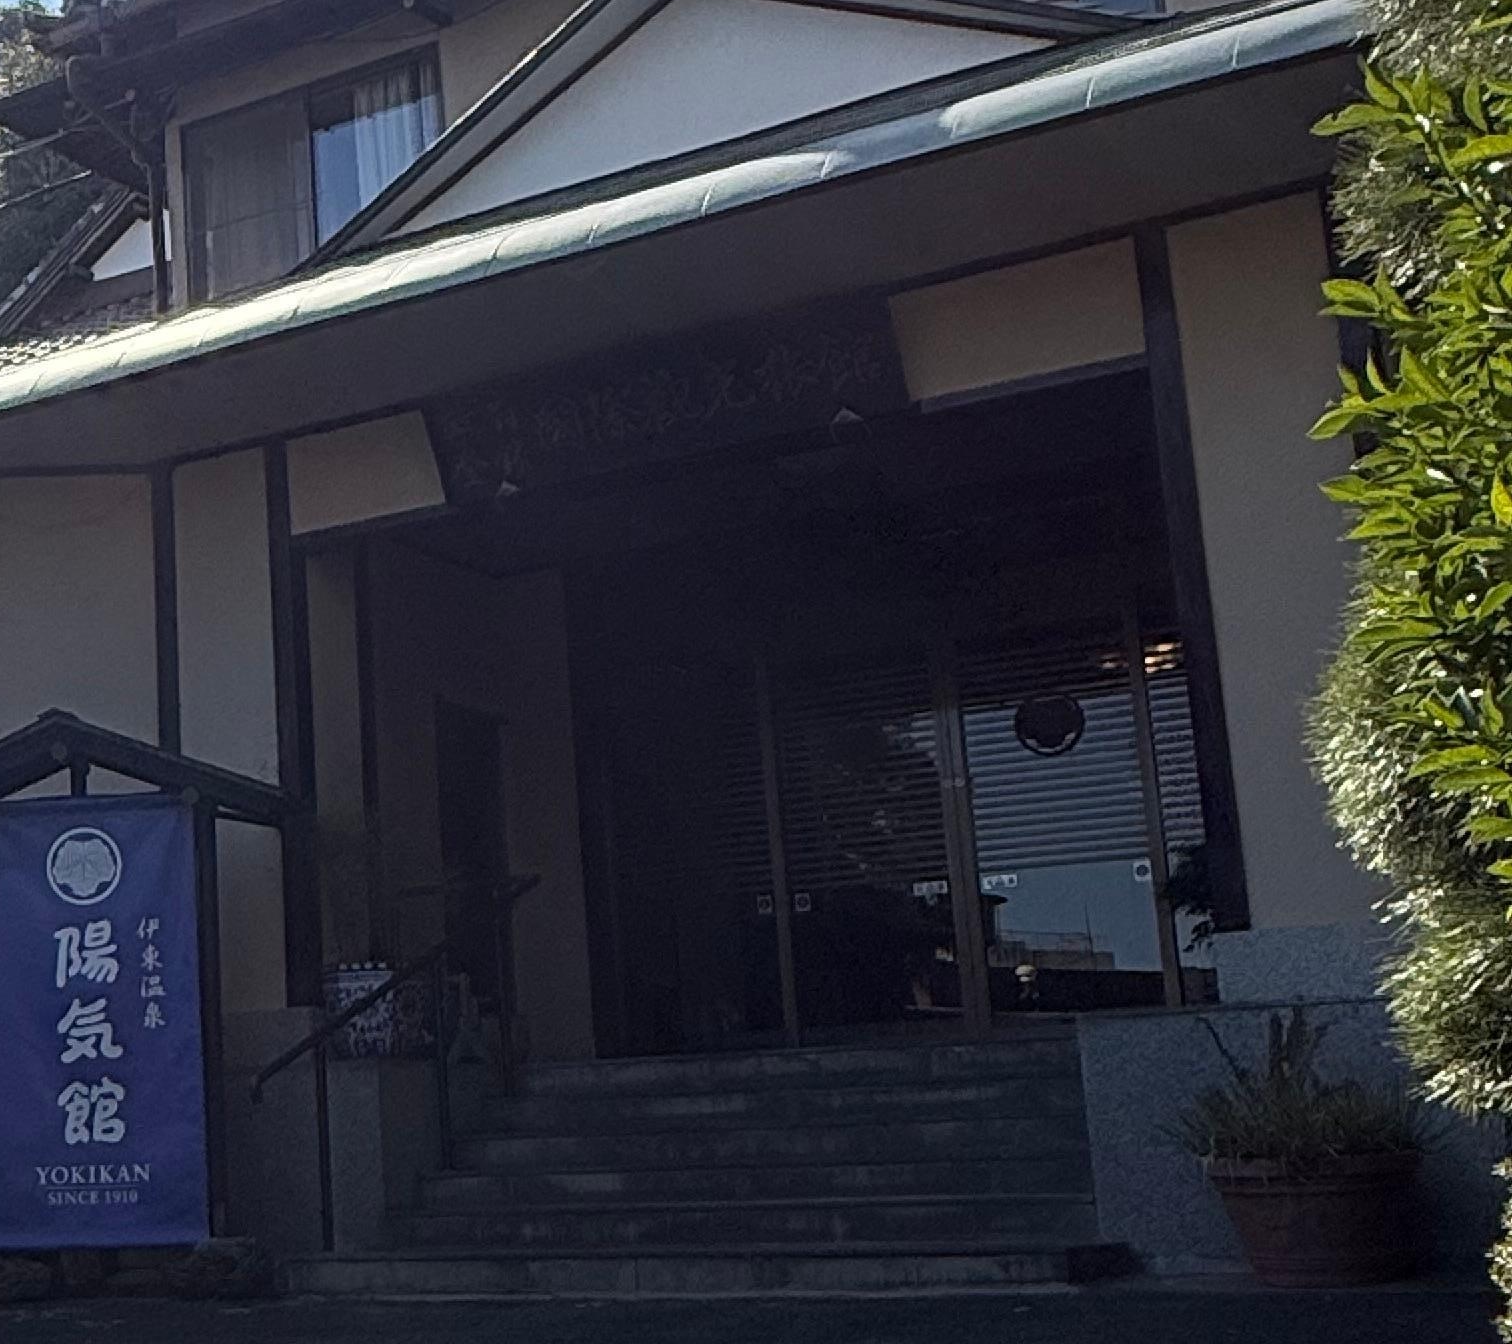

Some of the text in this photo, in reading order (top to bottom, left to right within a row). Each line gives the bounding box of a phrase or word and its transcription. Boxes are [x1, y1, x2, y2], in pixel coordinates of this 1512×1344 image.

[138, 917, 166, 1029] 伊東温泉
[54, 918, 126, 1145] 陽気館
[35, 1164, 150, 1185] YOKIKAN
[48, 1190, 99, 1205] SINCE
